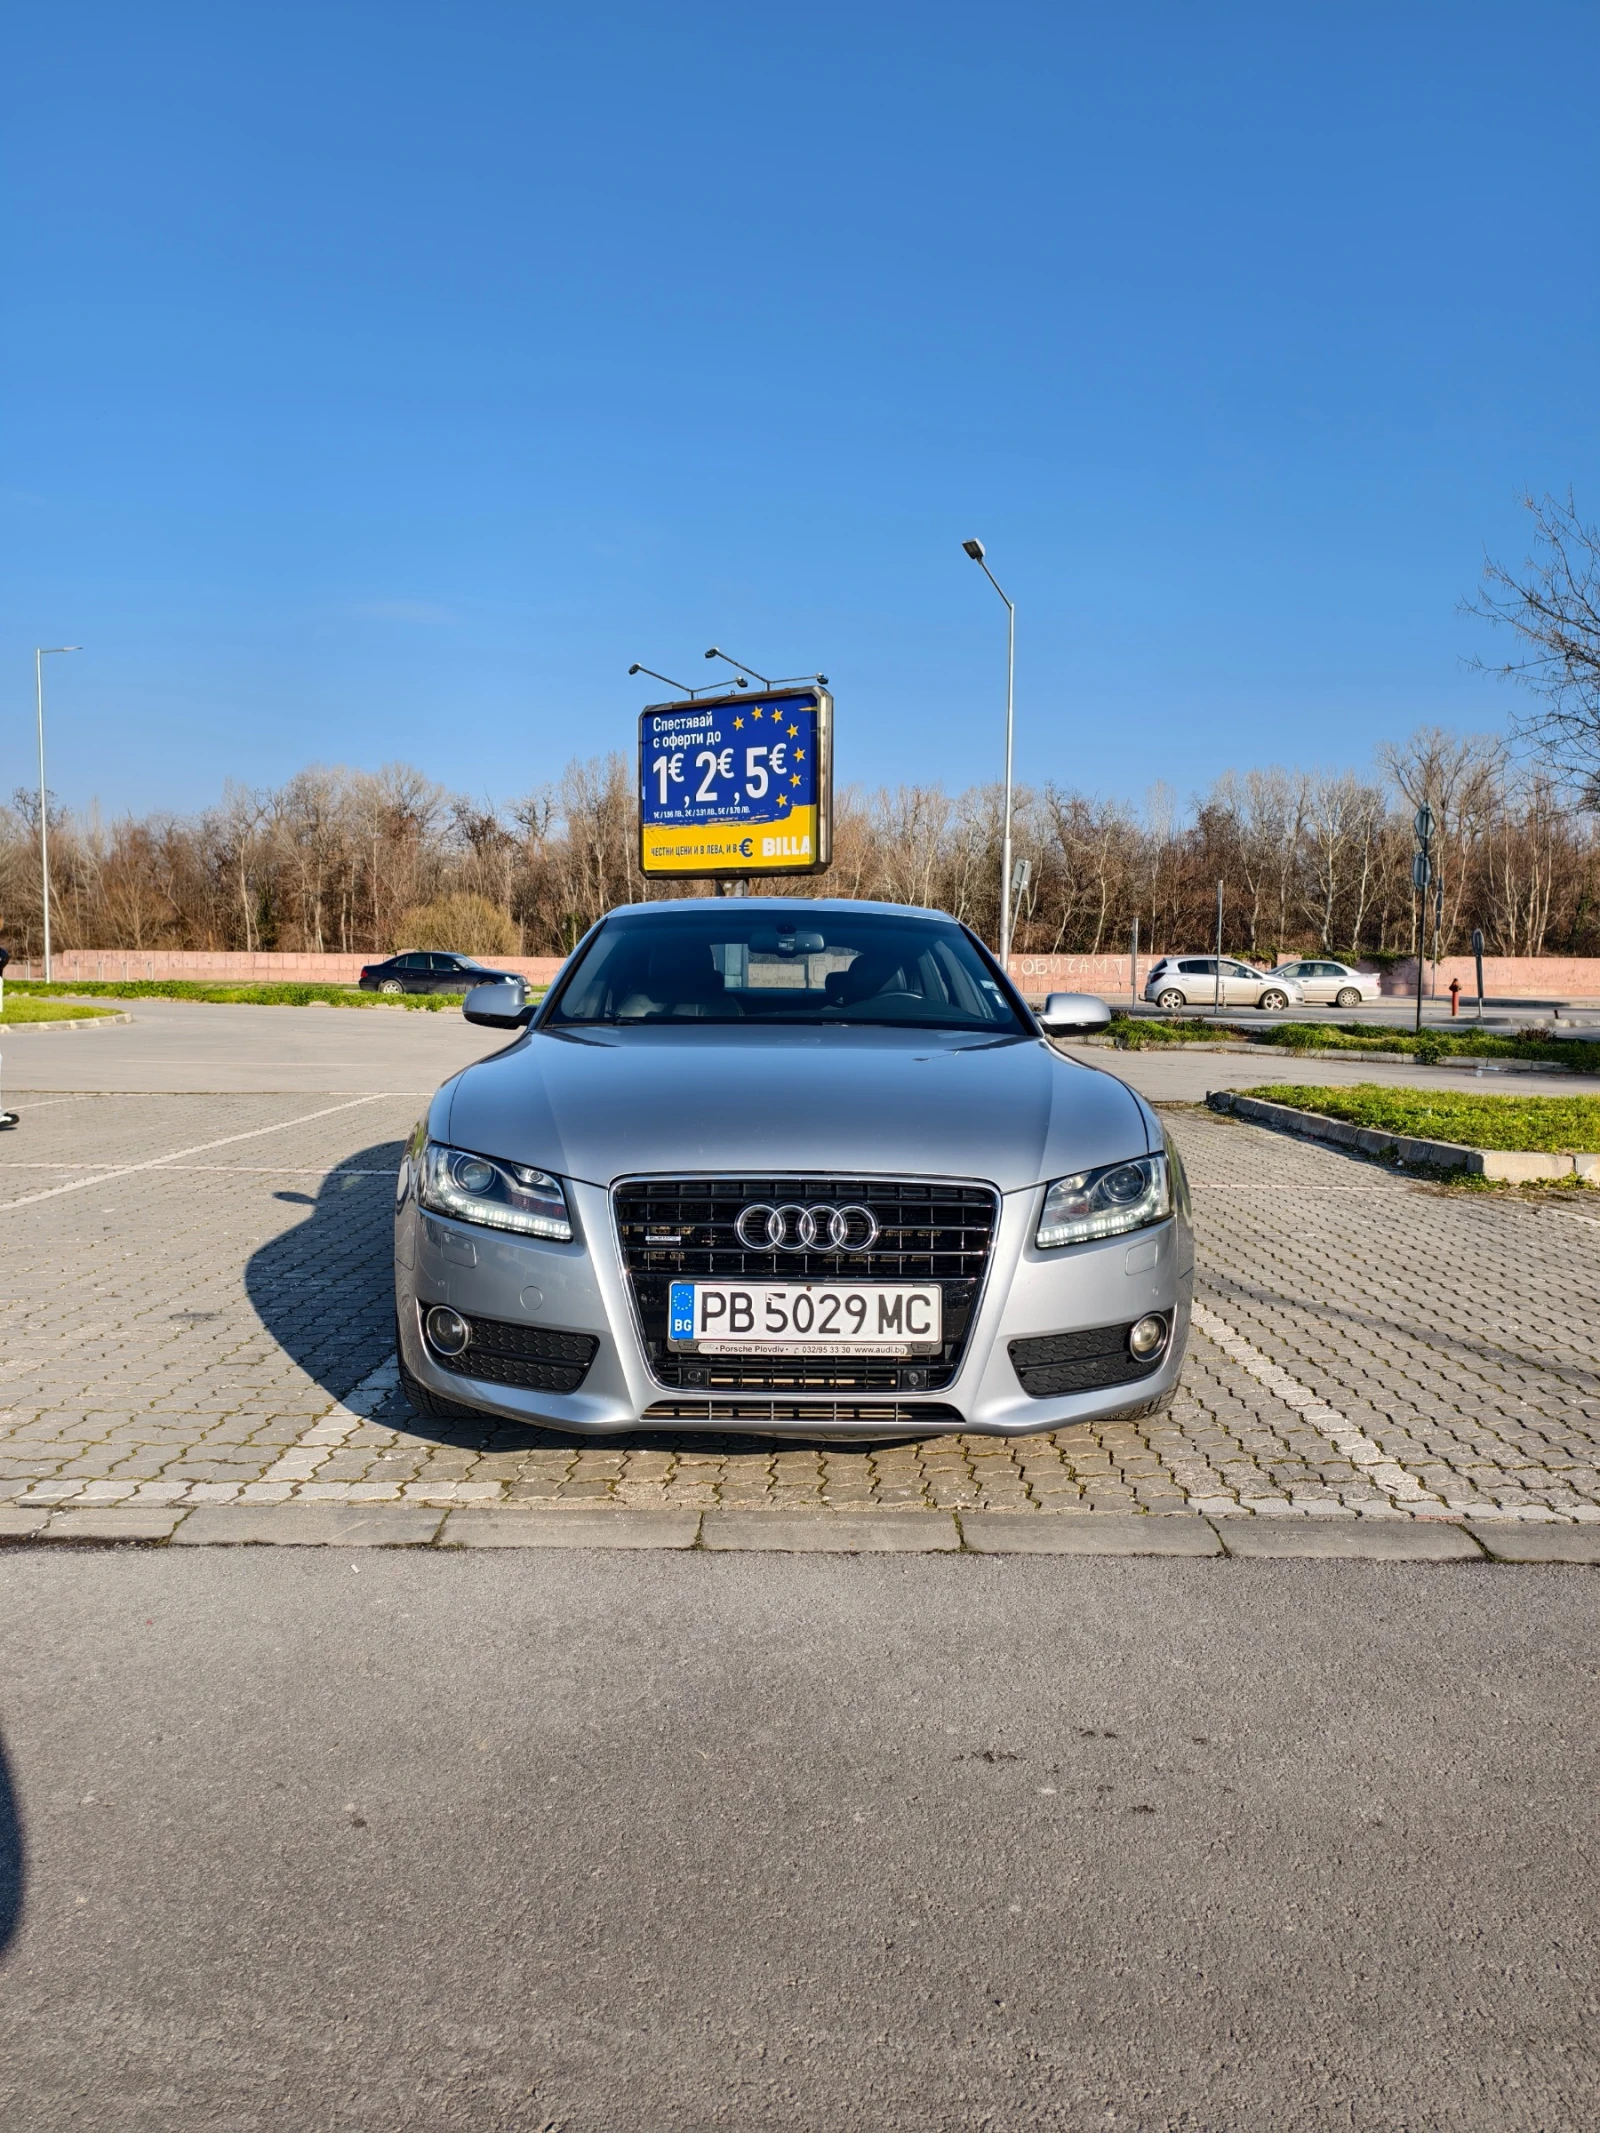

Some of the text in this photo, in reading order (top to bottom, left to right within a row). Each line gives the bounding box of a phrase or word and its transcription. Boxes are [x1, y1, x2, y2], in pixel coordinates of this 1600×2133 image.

[653, 711, 713, 732] Спестявай
[653, 731, 721, 750] с оферти до
[746, 743, 787, 799] 5€
[651, 846, 675, 857] ЧЕСТНИ
[675, 845, 693, 857] ЦЕНИ
[694, 845, 699, 855] И
[700, 845, 704, 854] В
[706, 844, 725, 855] ЛЕВА,
[726, 844, 731, 854] И
[732, 843, 737, 853] В
[762, 836, 812, 857] BILLA
[701, 1291, 931, 1335] PB 5029 MC
[674, 1318, 692, 1332] BG
[720, 1345, 905, 1355] Porsche Plovdiv 032/95 33 30 www.audi.bg
